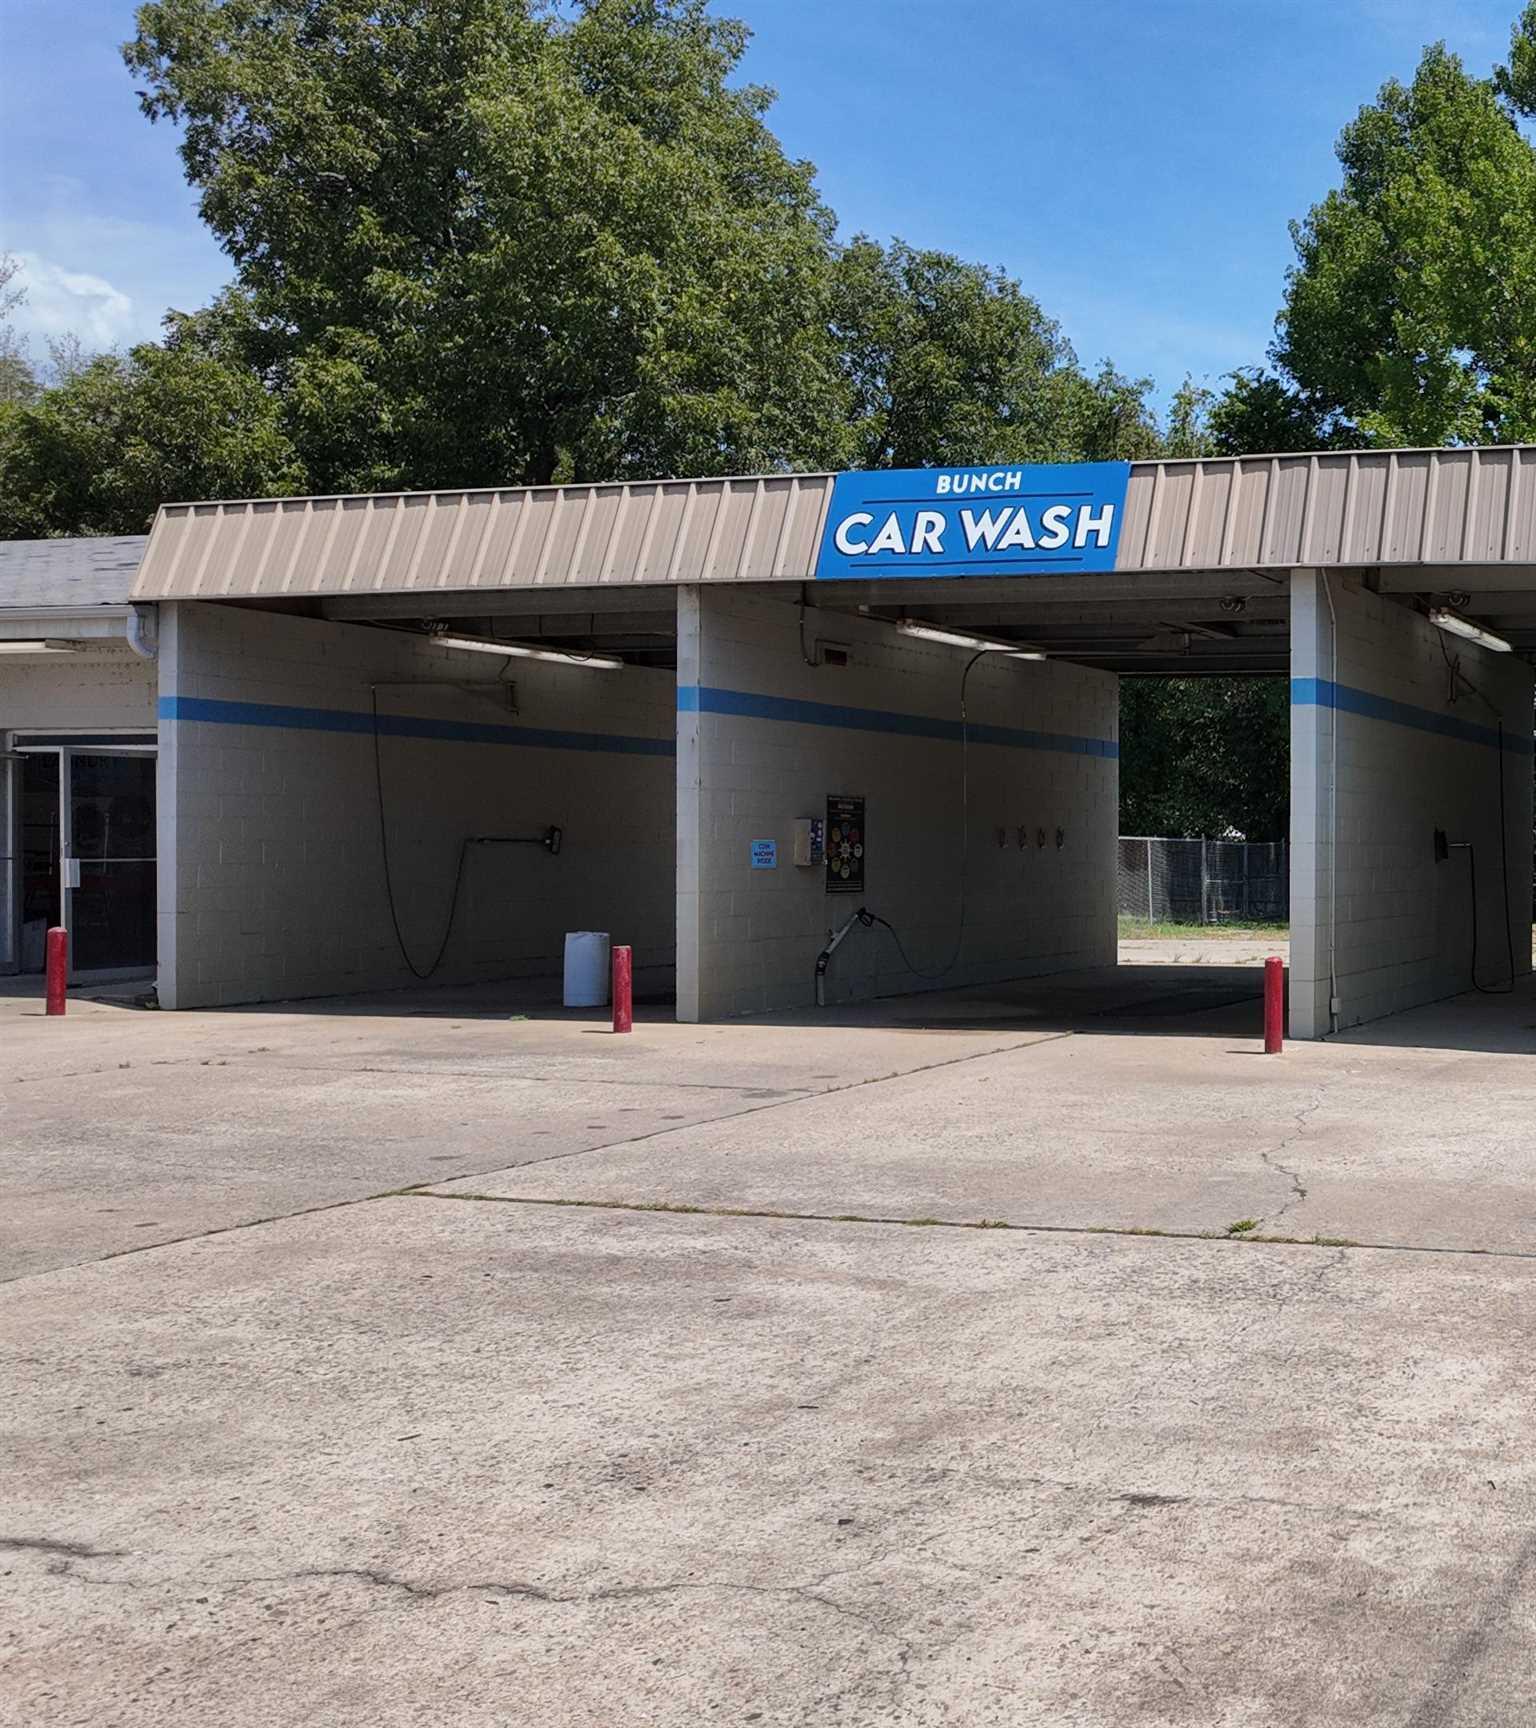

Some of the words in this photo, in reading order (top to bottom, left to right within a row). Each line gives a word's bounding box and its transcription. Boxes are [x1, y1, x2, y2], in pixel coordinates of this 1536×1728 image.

[936, 471, 1022, 494] BUNCH
[834, 512, 947, 556] CAR
[960, 504, 1116, 552] WASH
